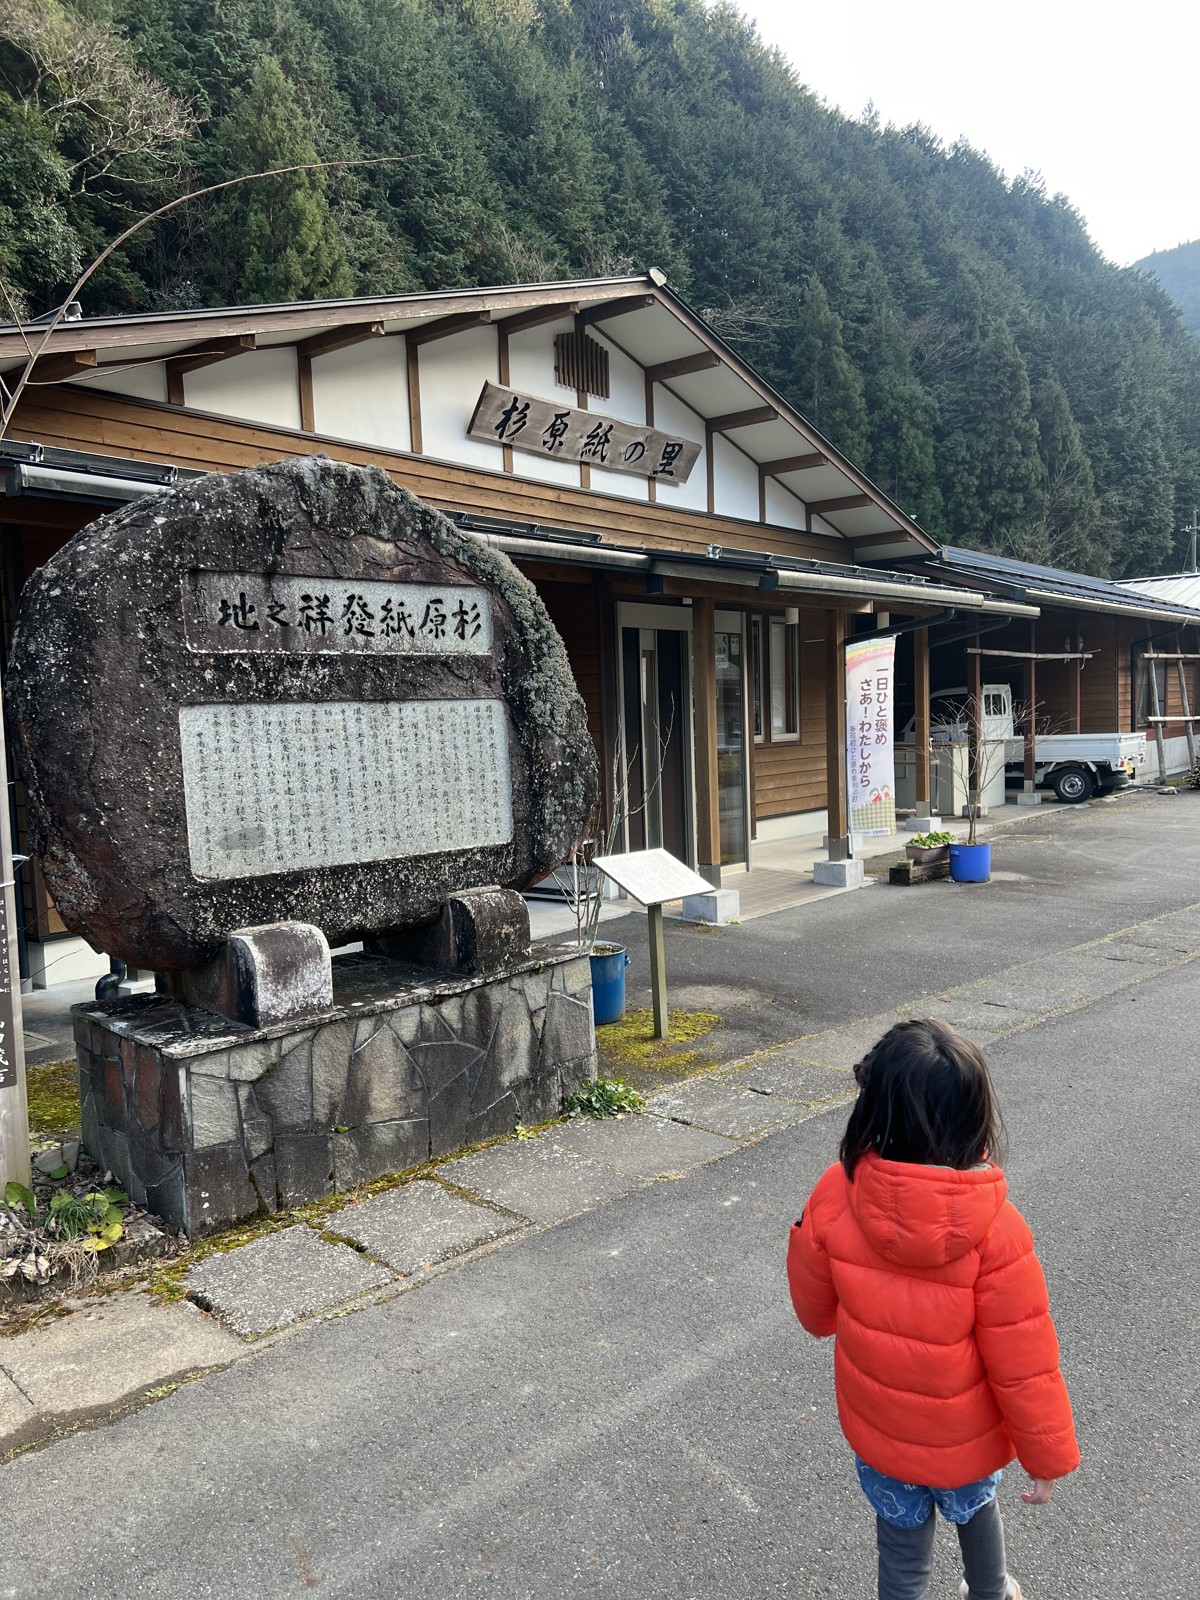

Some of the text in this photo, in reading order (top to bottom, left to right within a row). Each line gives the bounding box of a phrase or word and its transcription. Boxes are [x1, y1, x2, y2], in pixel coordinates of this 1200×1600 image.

[494, 395, 685, 477] 杉原紙の里
[874, 668, 889, 746] 一日ひと褒め
